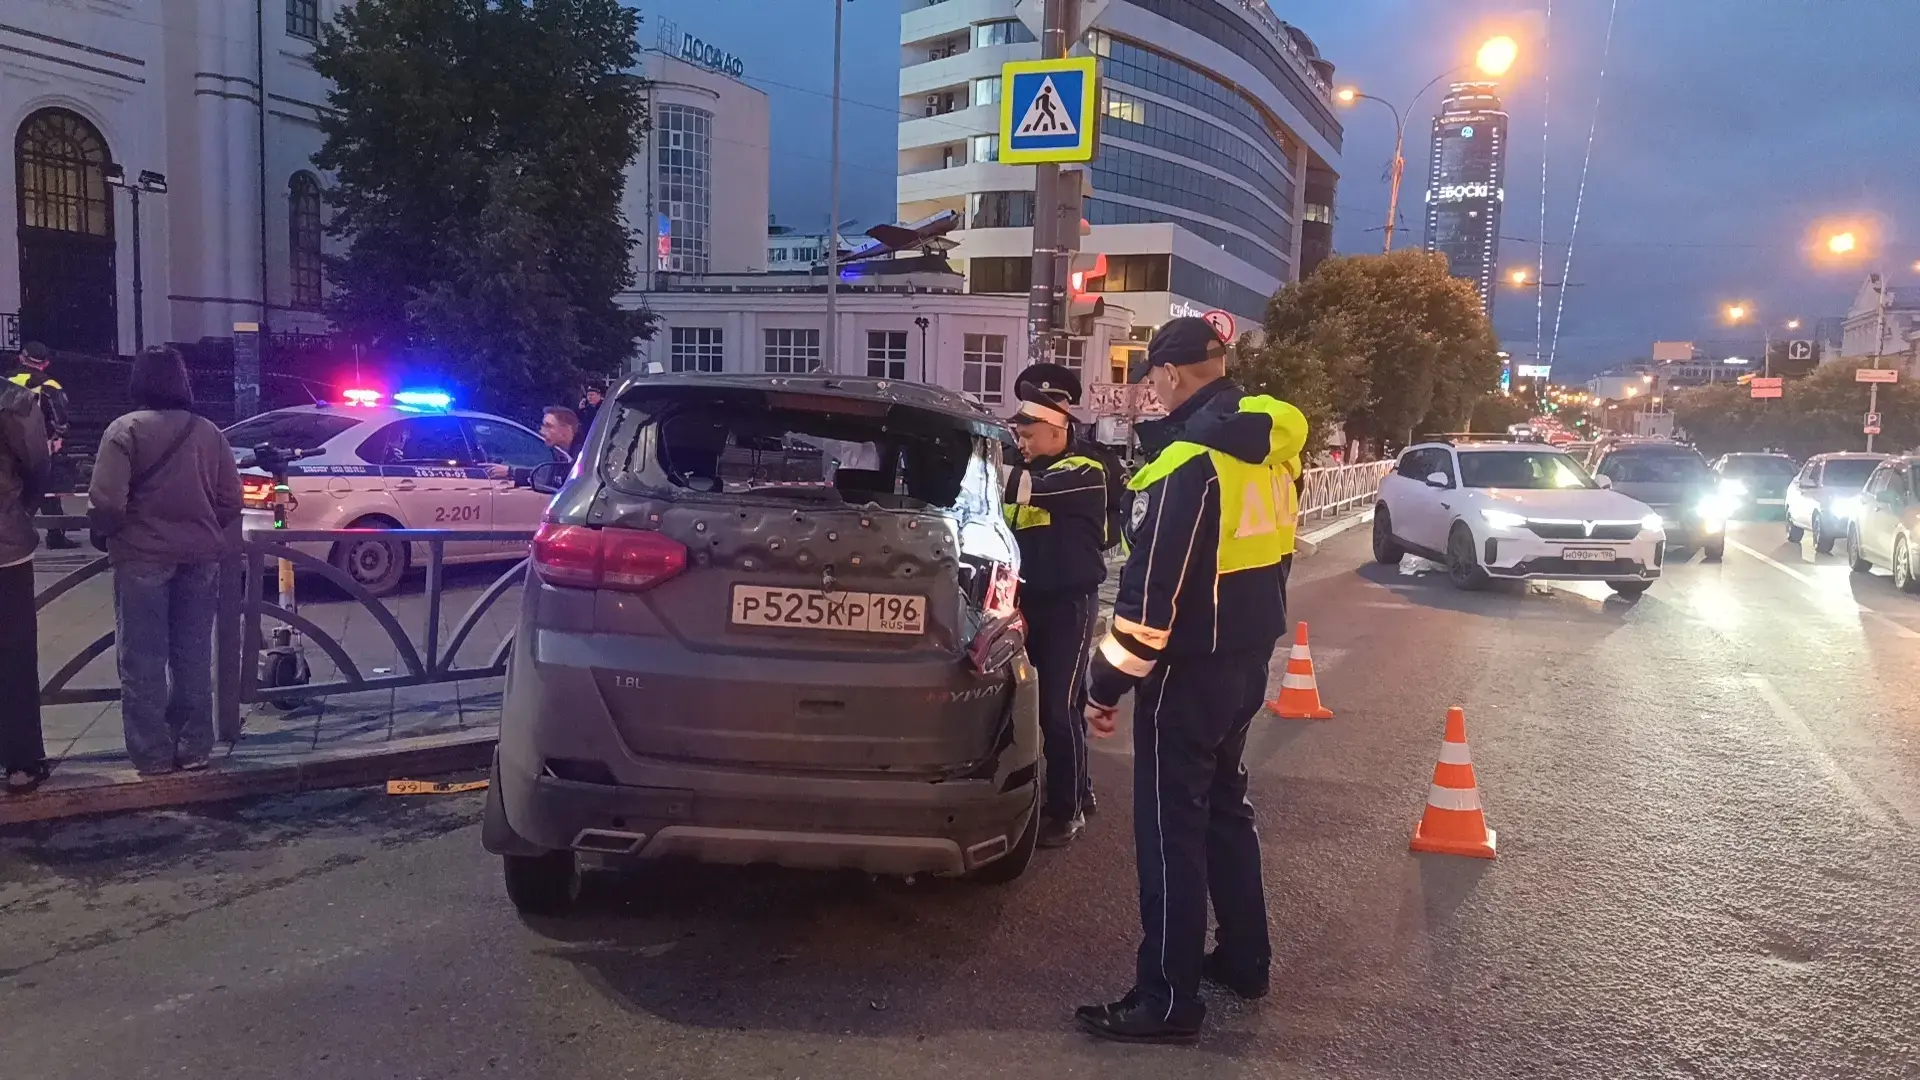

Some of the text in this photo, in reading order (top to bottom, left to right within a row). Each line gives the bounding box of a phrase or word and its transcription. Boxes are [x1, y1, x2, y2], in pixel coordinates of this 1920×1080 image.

[680, 32, 744, 77] ДОСААФ
[435, 505, 481, 523] 2-201
[742, 591, 918, 627] Р525КР 196
[880, 619, 903, 632] RUS
